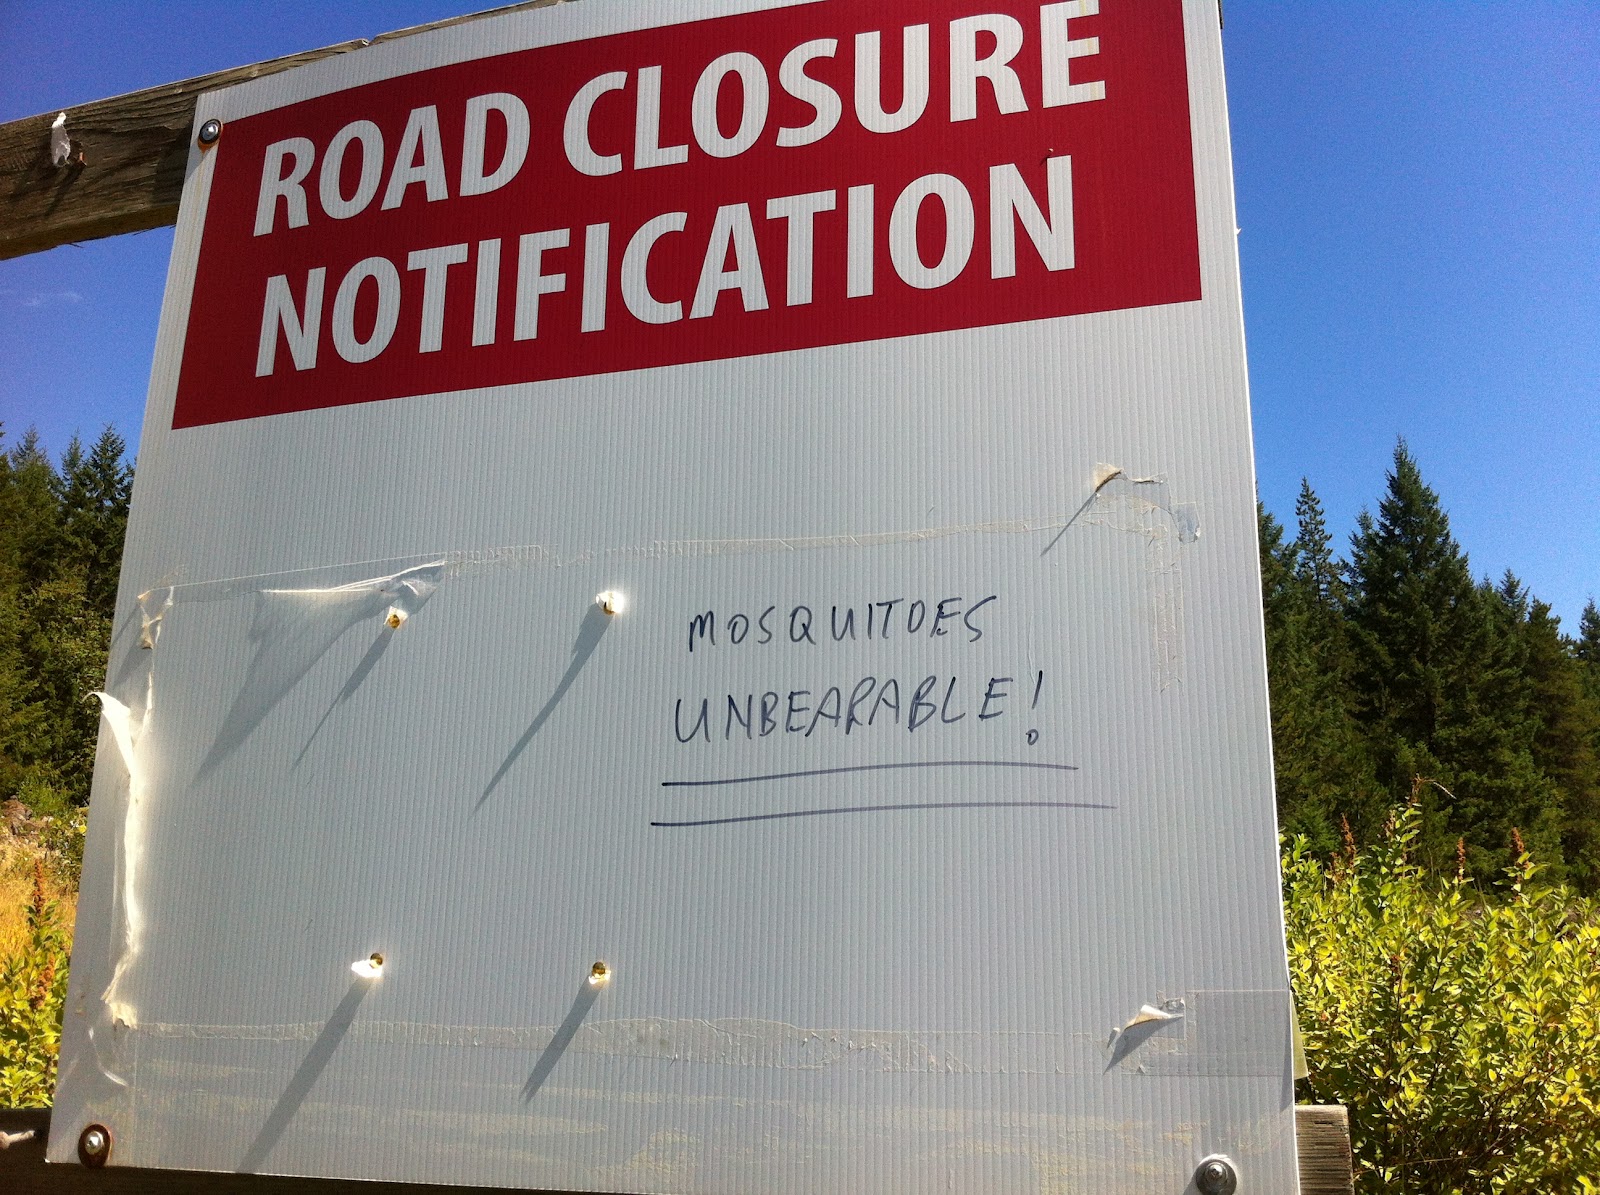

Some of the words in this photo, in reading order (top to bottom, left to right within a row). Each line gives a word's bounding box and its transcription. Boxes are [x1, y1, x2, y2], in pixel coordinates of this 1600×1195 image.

[253, 92, 531, 237] ROAD
[563, 0, 1106, 177] CLOSURE
[255, 154, 1076, 378] NOTIFICATION
[688, 594, 998, 653] MOSQUITOES
[674, 669, 1044, 746] UNBEARABLE!
